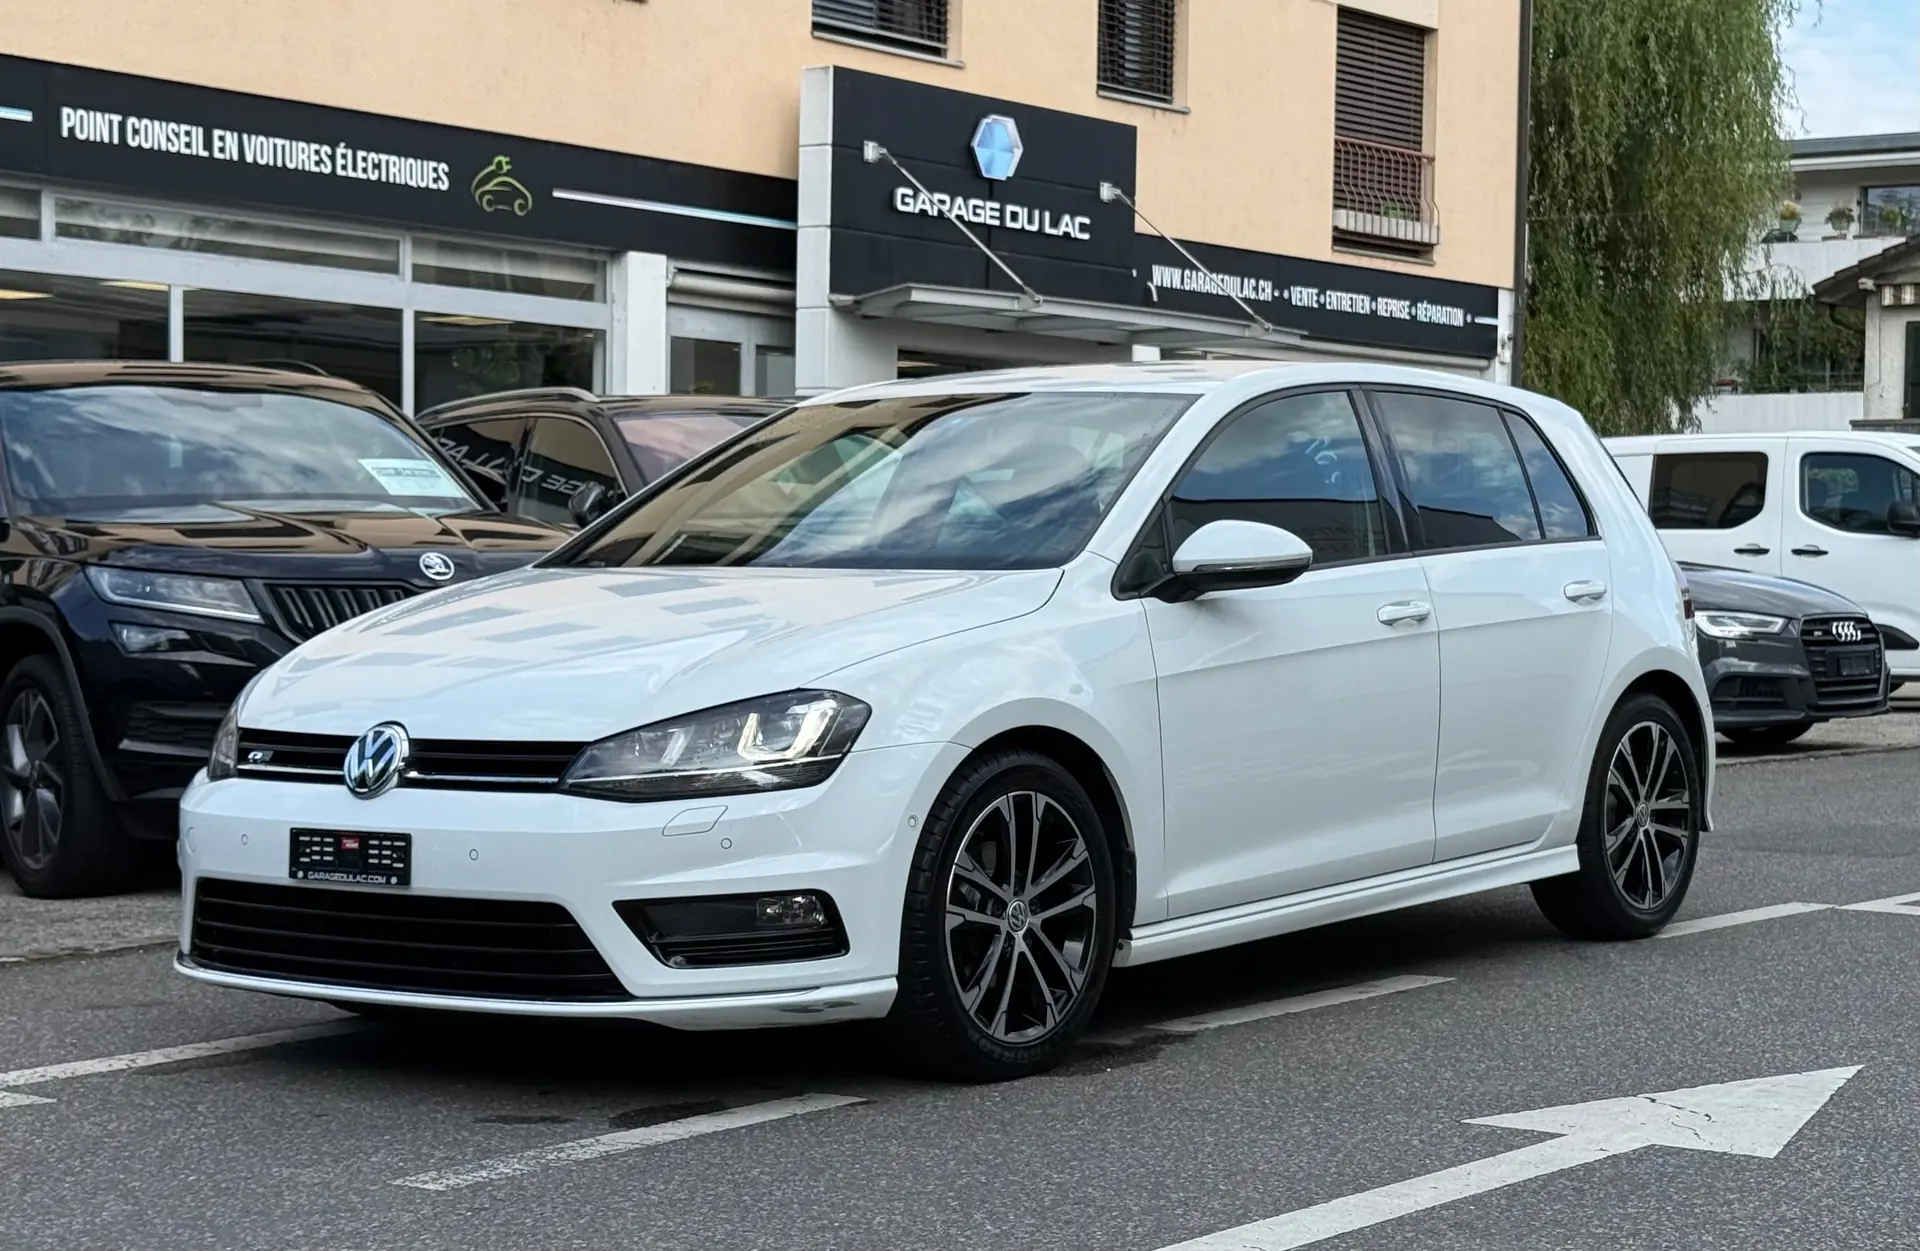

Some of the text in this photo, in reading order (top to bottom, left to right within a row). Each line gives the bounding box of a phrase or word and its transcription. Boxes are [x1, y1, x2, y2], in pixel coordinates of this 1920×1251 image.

[60, 106, 450, 191] POINT CONSEIL EN VOITURES ÉLECTRIQUES
[894, 187, 1091, 241] GARAGE DU LAC
[1151, 264, 1273, 302] WWW.GARAGEDULAC.CH
[1290, 285, 1464, 328] VENTE ENTRETIEN REPRISE RÉPARATION
[307, 871, 387, 884] GARAGEDULAC.COM
